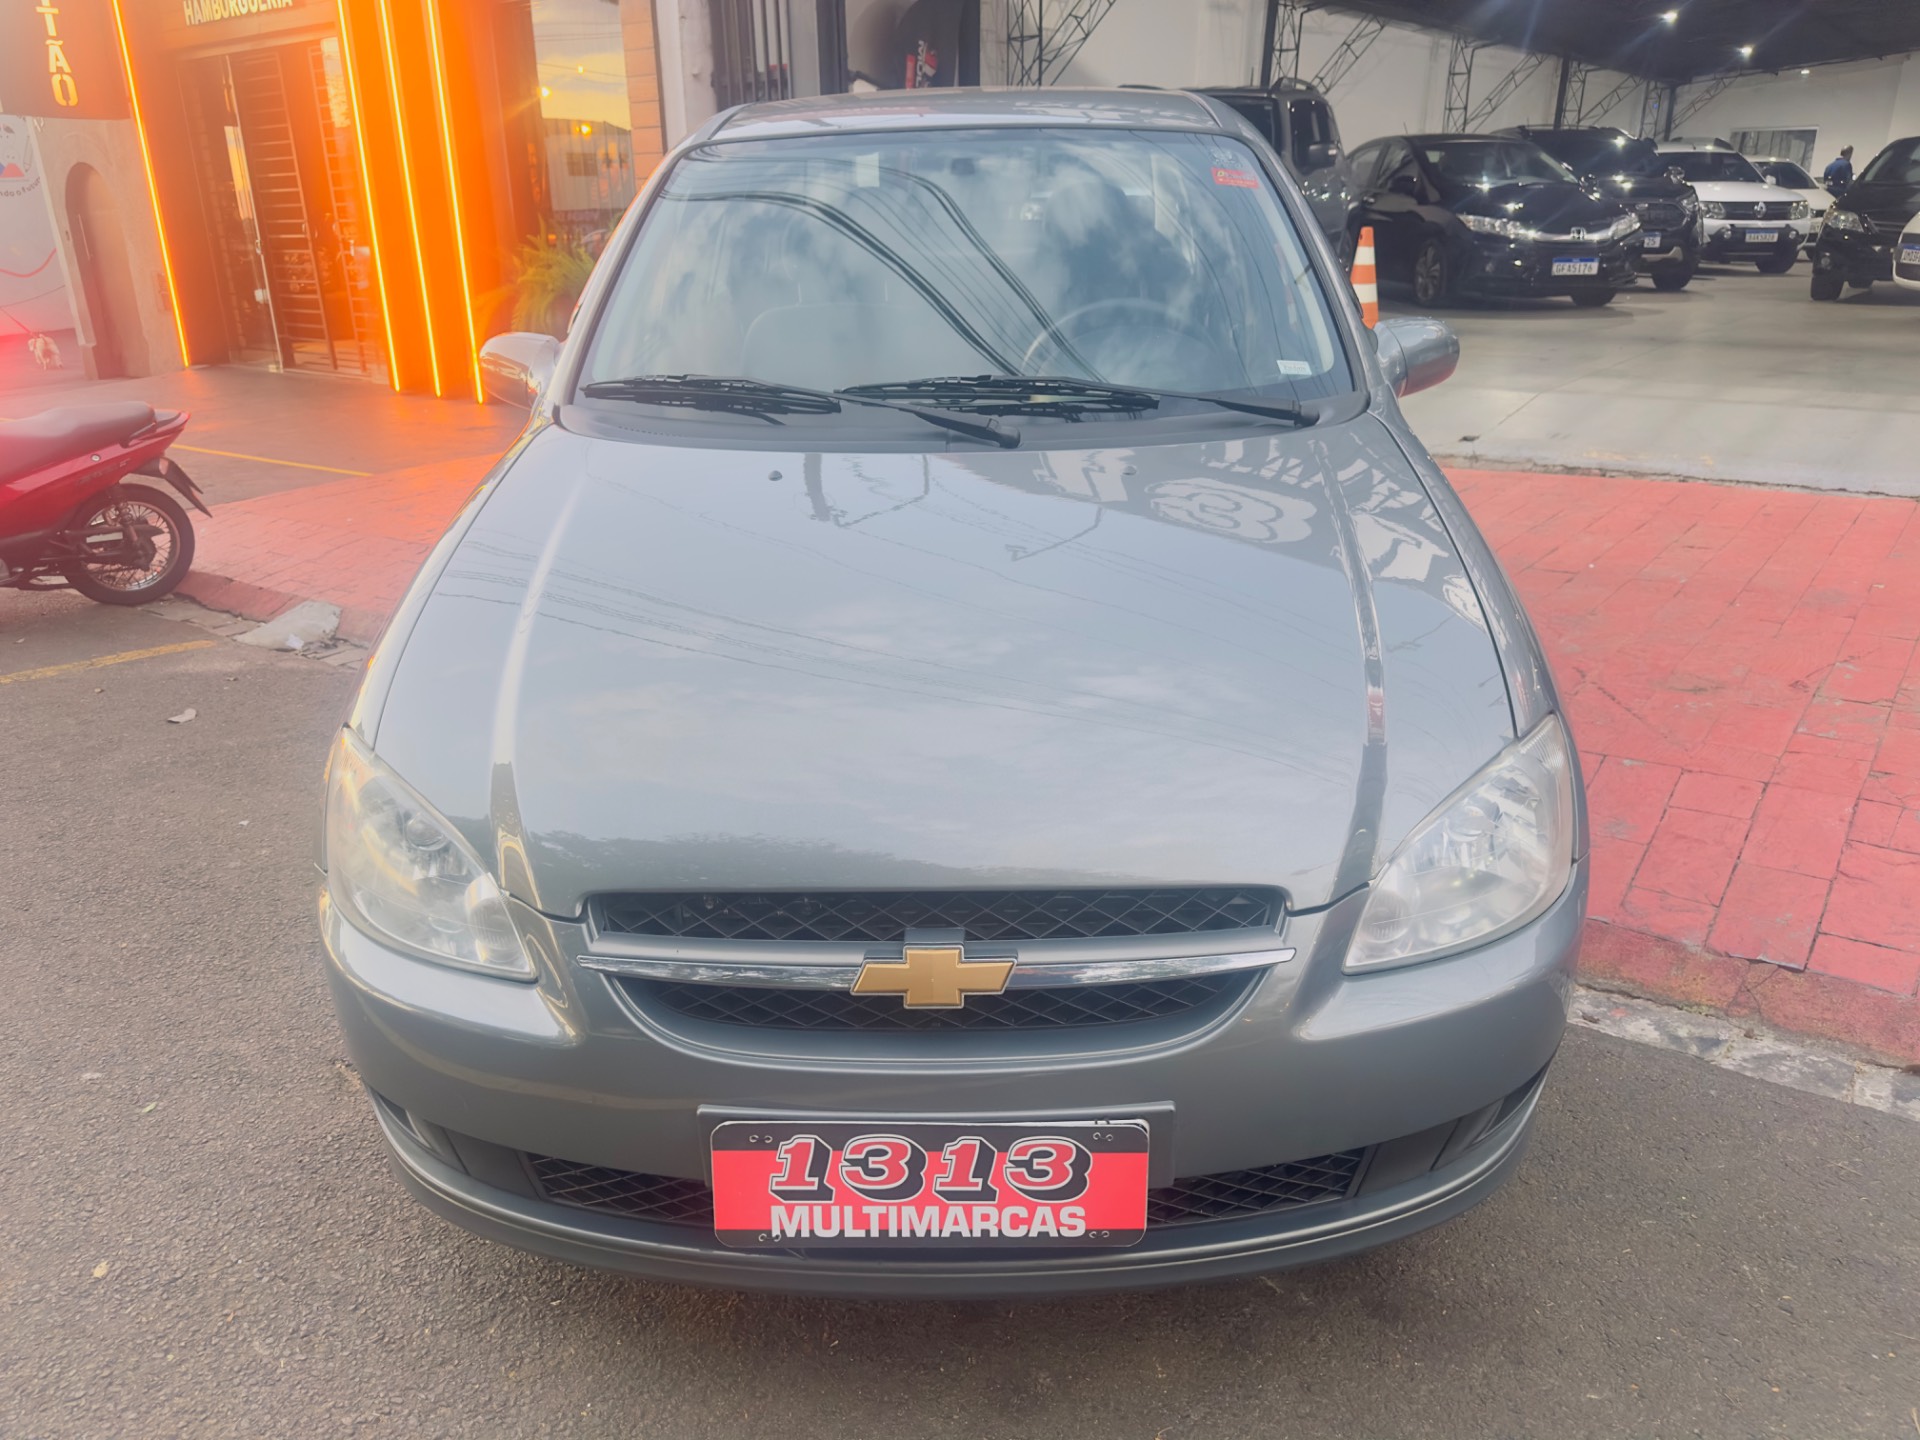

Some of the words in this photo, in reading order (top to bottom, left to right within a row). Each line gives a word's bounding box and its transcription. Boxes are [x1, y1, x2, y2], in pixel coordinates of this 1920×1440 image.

[35, 0, 79, 107] TÃO
[768, 1133, 1094, 1204] 1313
[770, 1205, 1086, 1239] MULTIMARCAS
